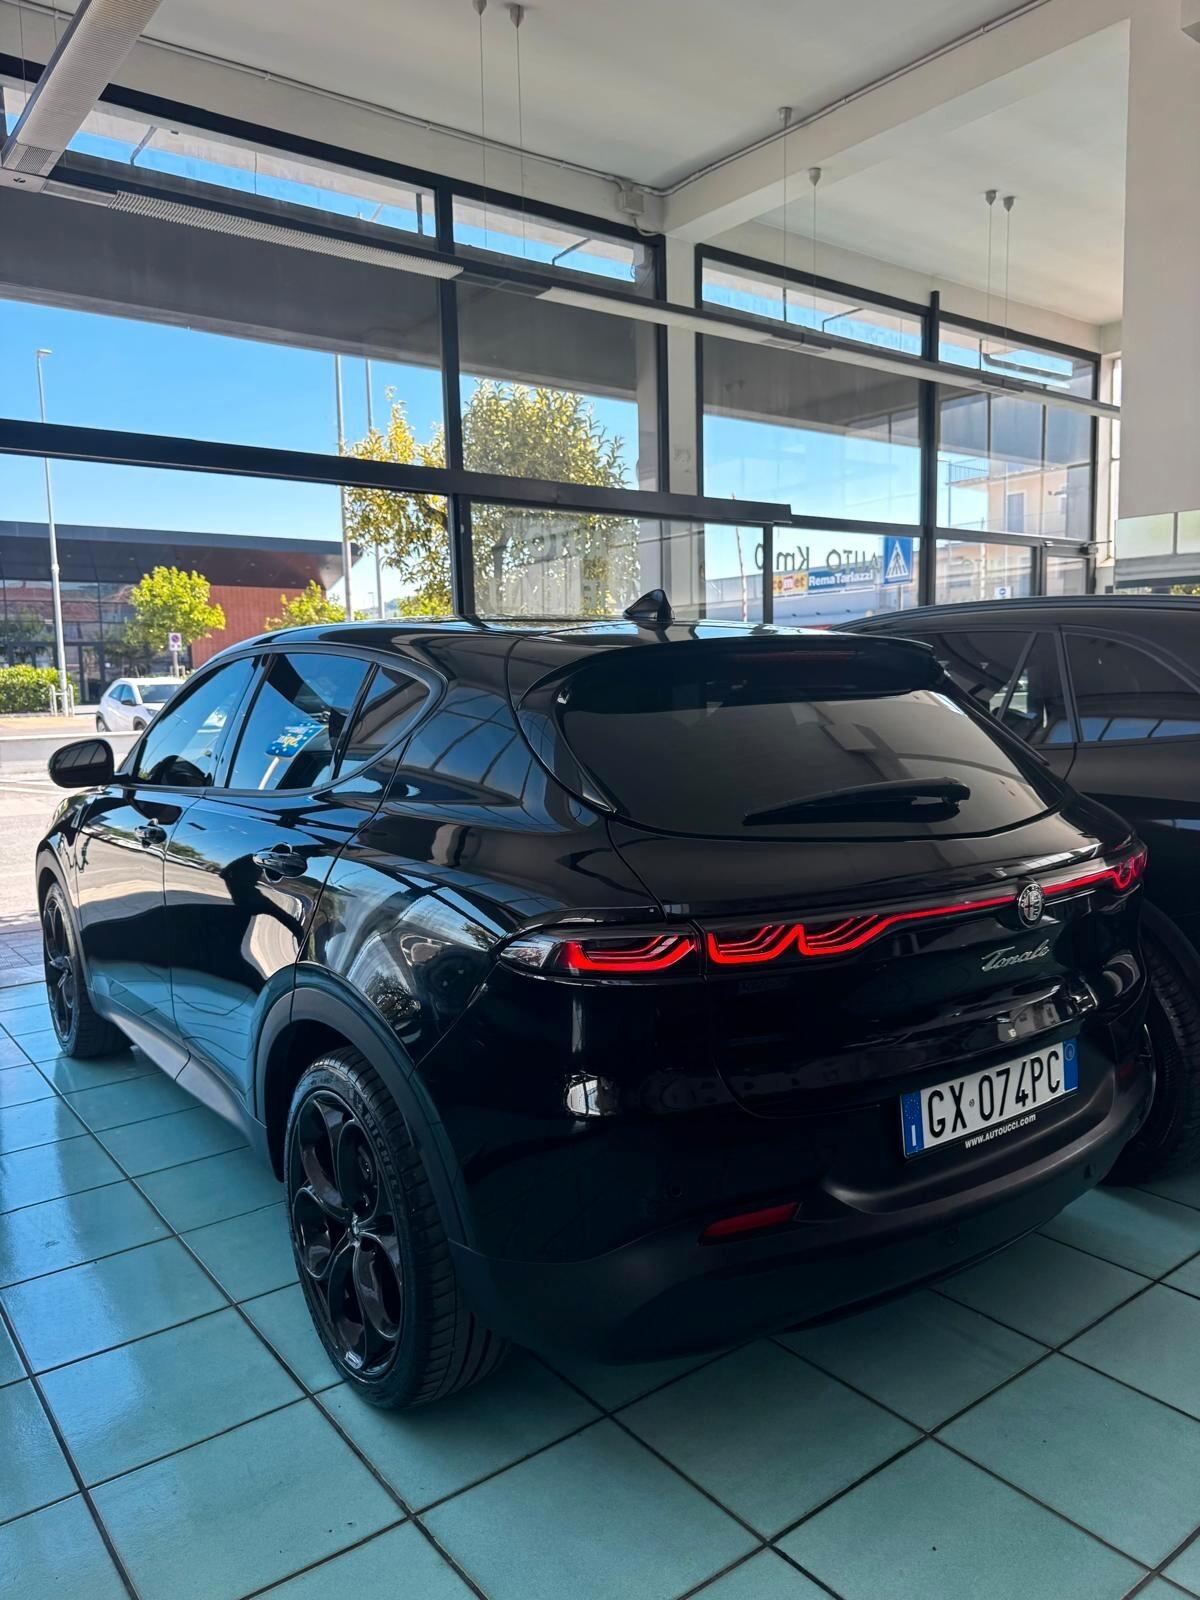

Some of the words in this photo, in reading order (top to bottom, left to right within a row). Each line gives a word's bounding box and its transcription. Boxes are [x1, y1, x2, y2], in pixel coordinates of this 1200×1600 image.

[981, 939, 1050, 972] Tonale
[928, 1082, 968, 1138] GX
[978, 1050, 1061, 1121] 074PC
